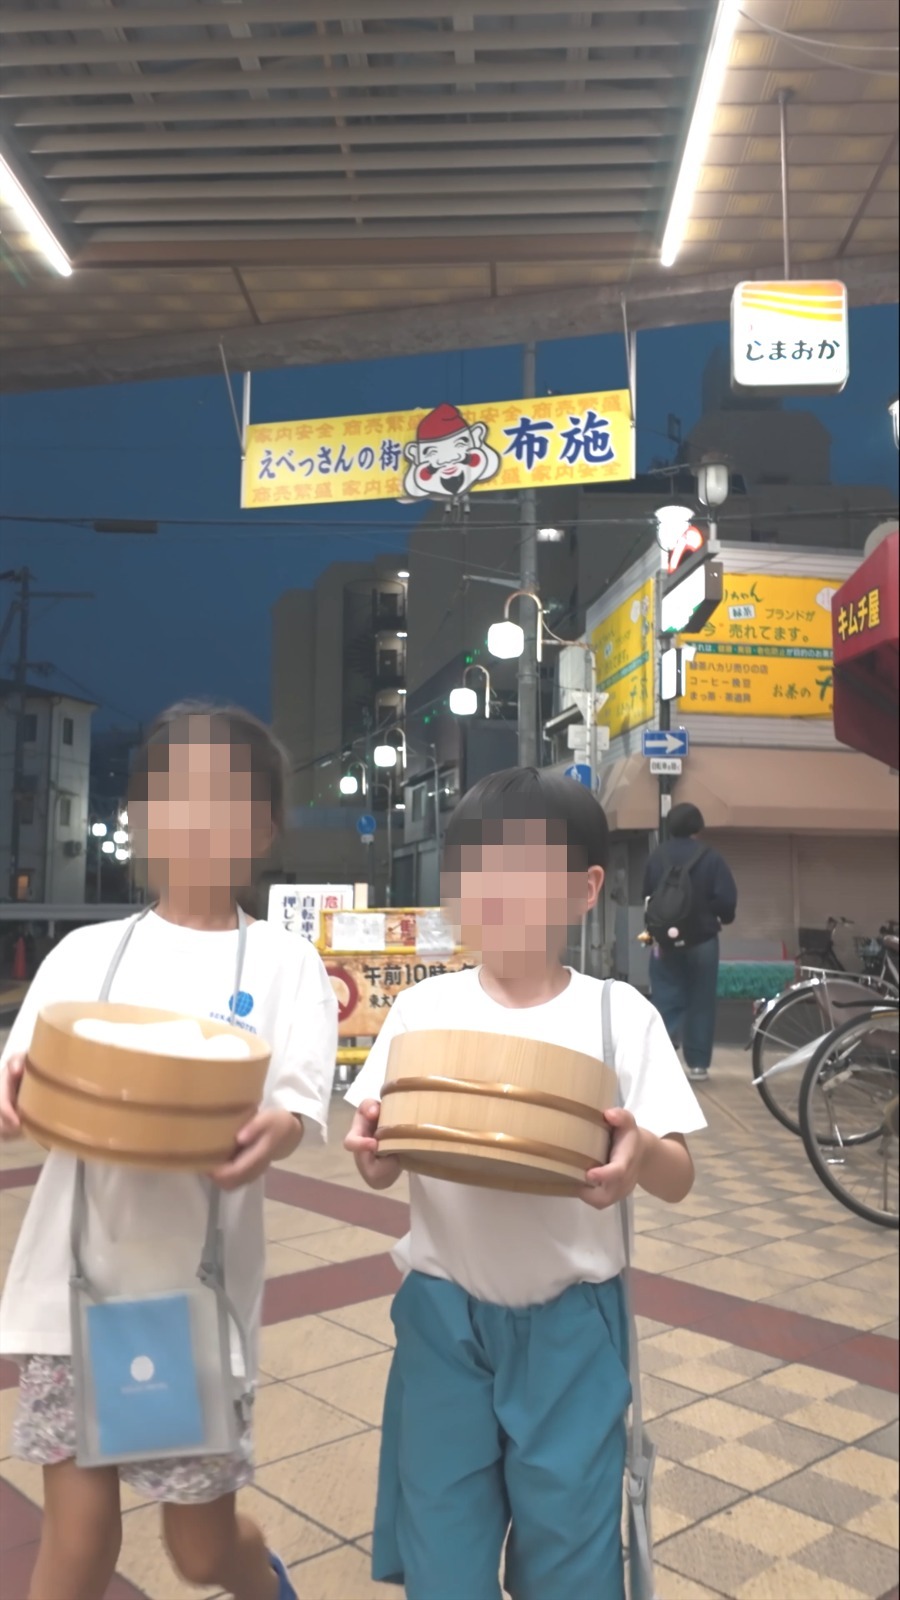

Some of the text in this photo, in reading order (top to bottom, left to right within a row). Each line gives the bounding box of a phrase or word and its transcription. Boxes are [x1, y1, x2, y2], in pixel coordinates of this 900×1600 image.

[746, 340, 840, 361] じまおか
[254, 423, 334, 443] 家内安全
[343, 413, 426, 436] 商売繁盛
[532, 395, 621, 419] 商売繁盛
[259, 411, 614, 480] えべっさんの街 布施
[253, 482, 333, 502] 商売繁盛
[531, 462, 621, 482] 家内安全
[765, 608, 815, 621] ブランドが
[838, 589, 880, 641] キムチ屋
[282, 896, 297, 932] 押して
[325, 895, 338, 909] 危
[369, 993, 396, 1008] 東大
